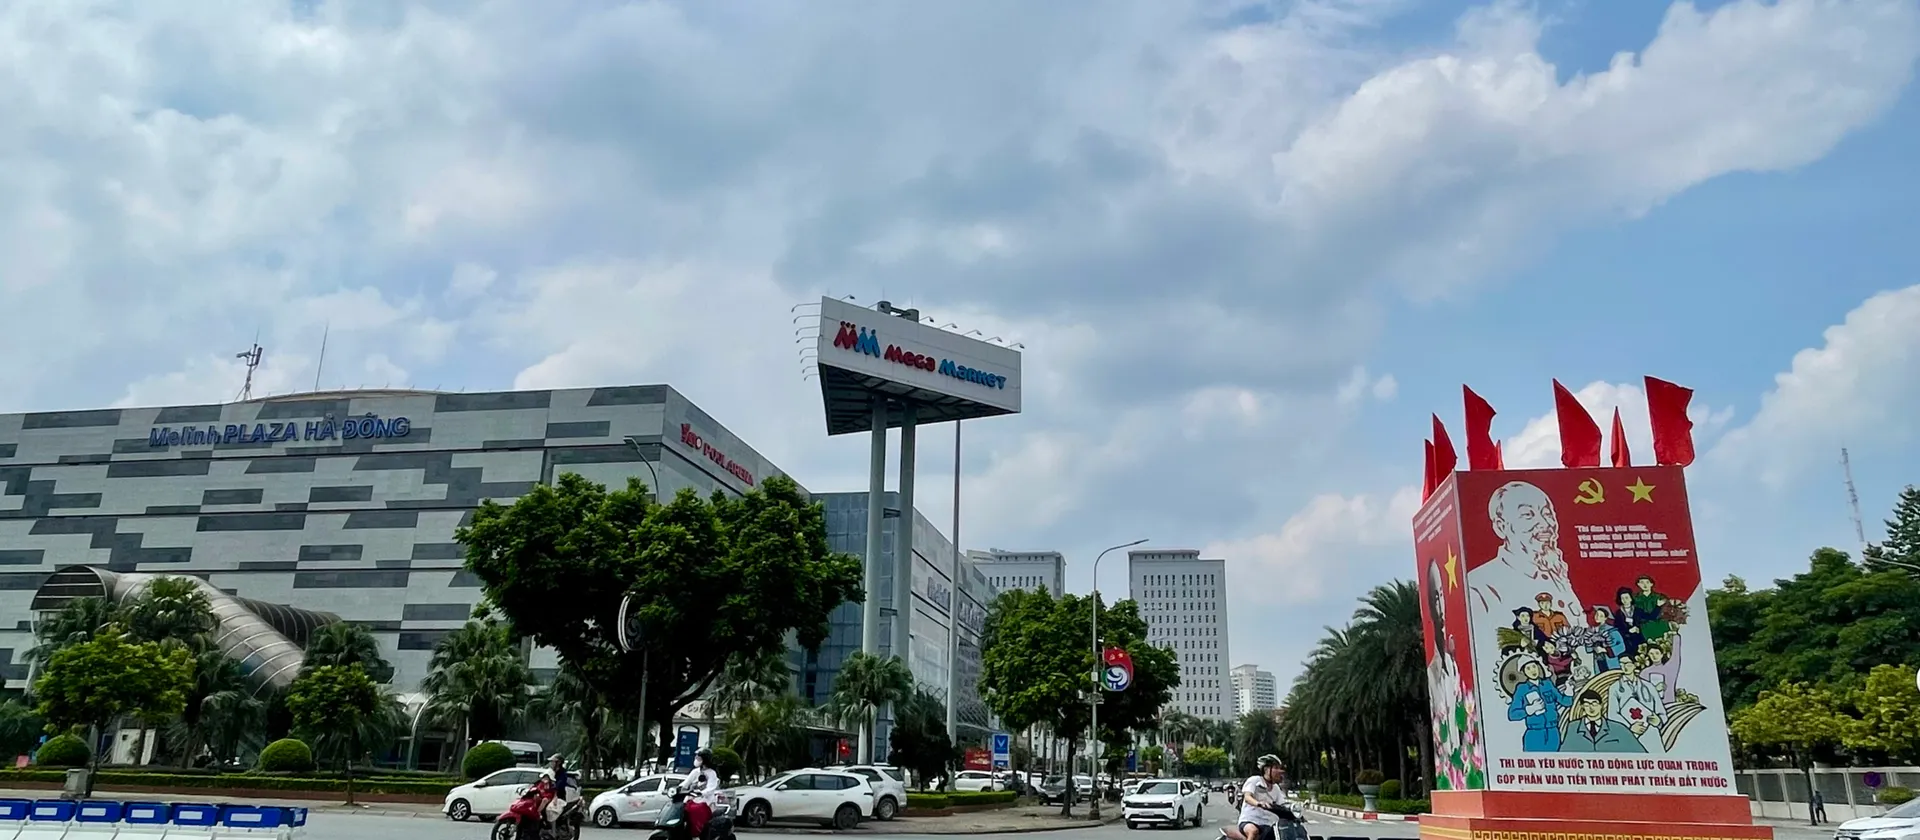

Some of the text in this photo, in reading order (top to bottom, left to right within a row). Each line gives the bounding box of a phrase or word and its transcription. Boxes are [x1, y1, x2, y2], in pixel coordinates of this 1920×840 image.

[223, 422, 299, 444] PLAZA
[304, 412, 337, 441] HÀ
[1499, 758, 1515, 769] THI
[1538, 757, 1555, 769] YÊU
[1657, 760, 1683, 771] QUAN
